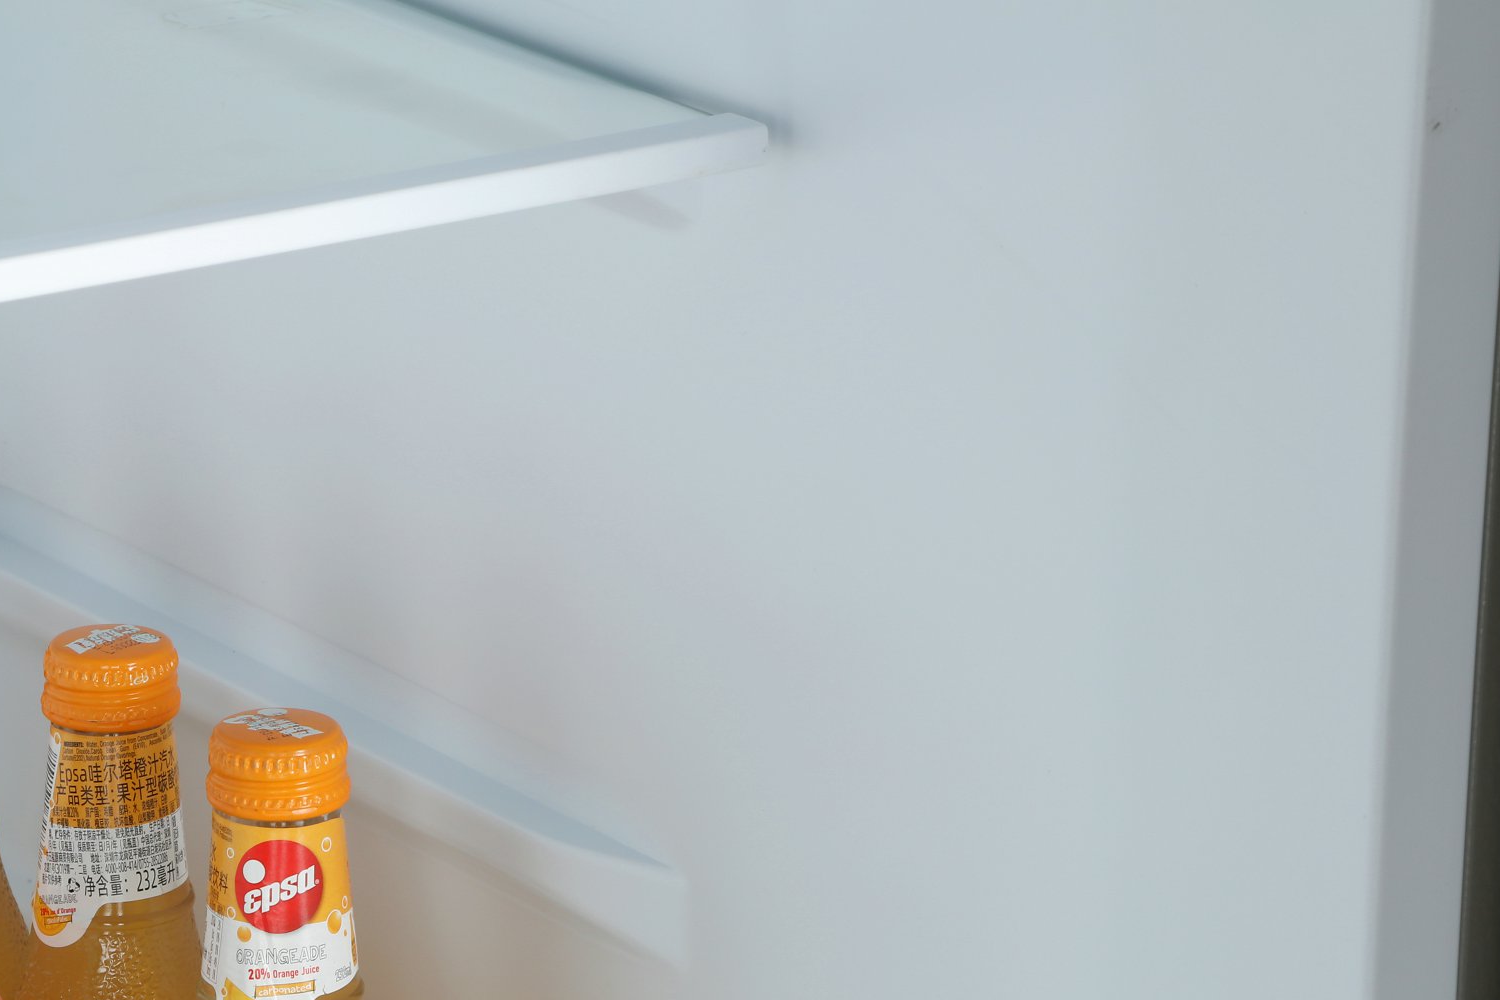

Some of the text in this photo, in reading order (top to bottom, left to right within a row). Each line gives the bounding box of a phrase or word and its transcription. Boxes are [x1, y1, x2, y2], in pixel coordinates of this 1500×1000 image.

[243, 865, 317, 914] epsa
[236, 944, 328, 966] ORANGEADE
[248, 965, 320, 981] 20% Orange Juice
[258, 982, 312, 997] carbonated
